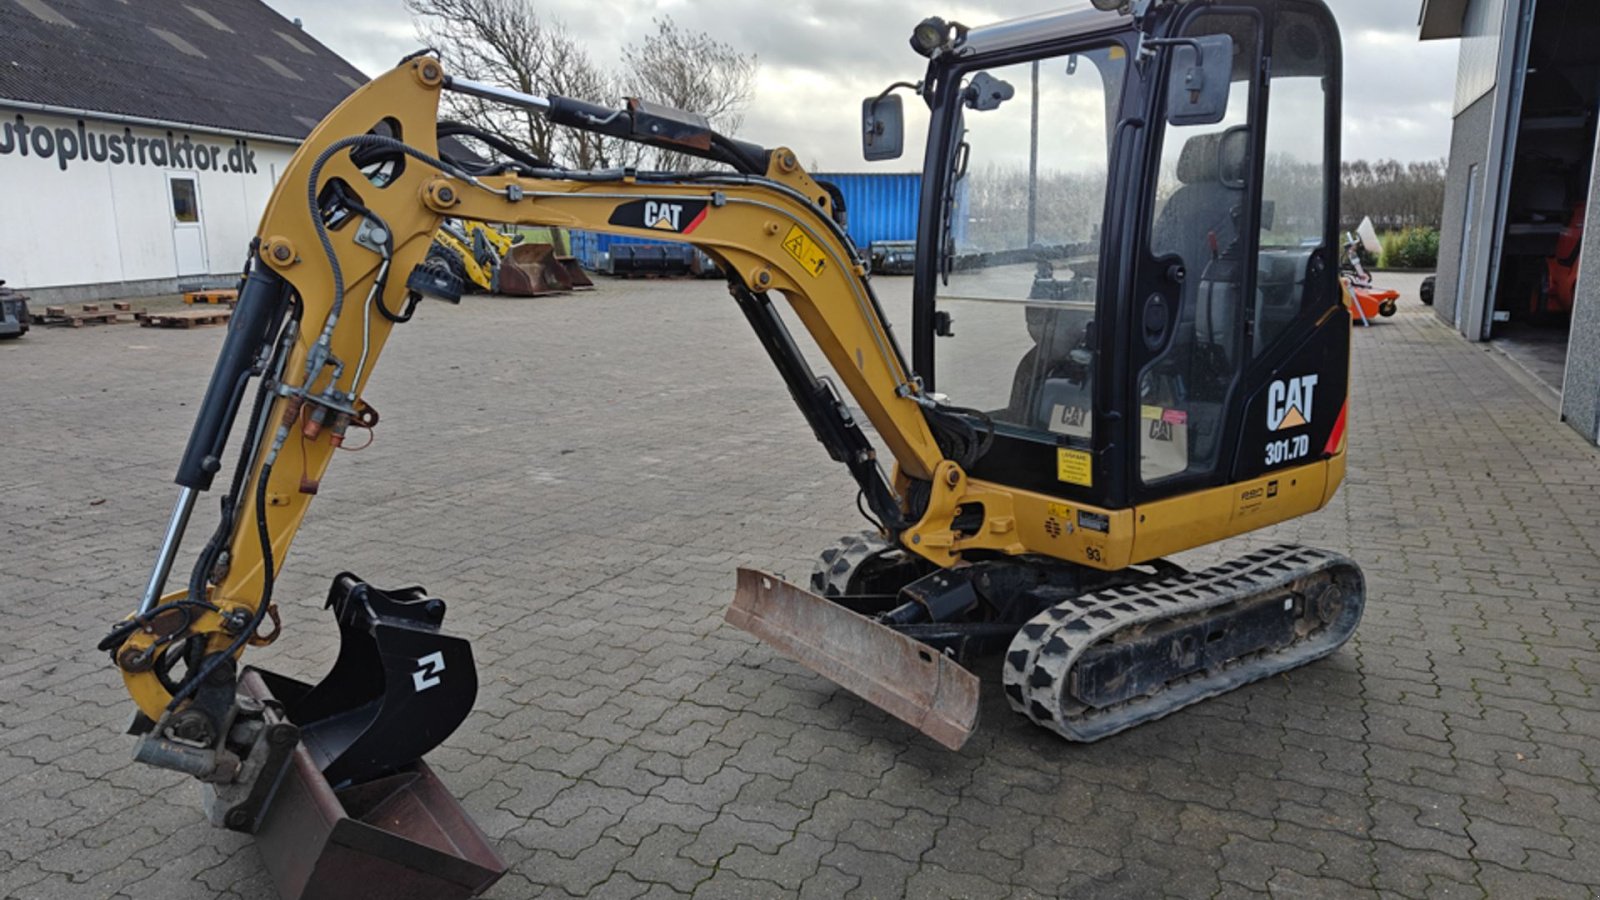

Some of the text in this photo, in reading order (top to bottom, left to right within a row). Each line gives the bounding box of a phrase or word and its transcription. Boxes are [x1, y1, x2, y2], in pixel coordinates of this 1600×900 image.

[645, 201, 682, 231] CAT
[1061, 405, 1086, 428] CAT
[1267, 374, 1318, 431] CAT
[1265, 434, 1309, 465] 301.7D
[1086, 546, 1101, 562] 93
